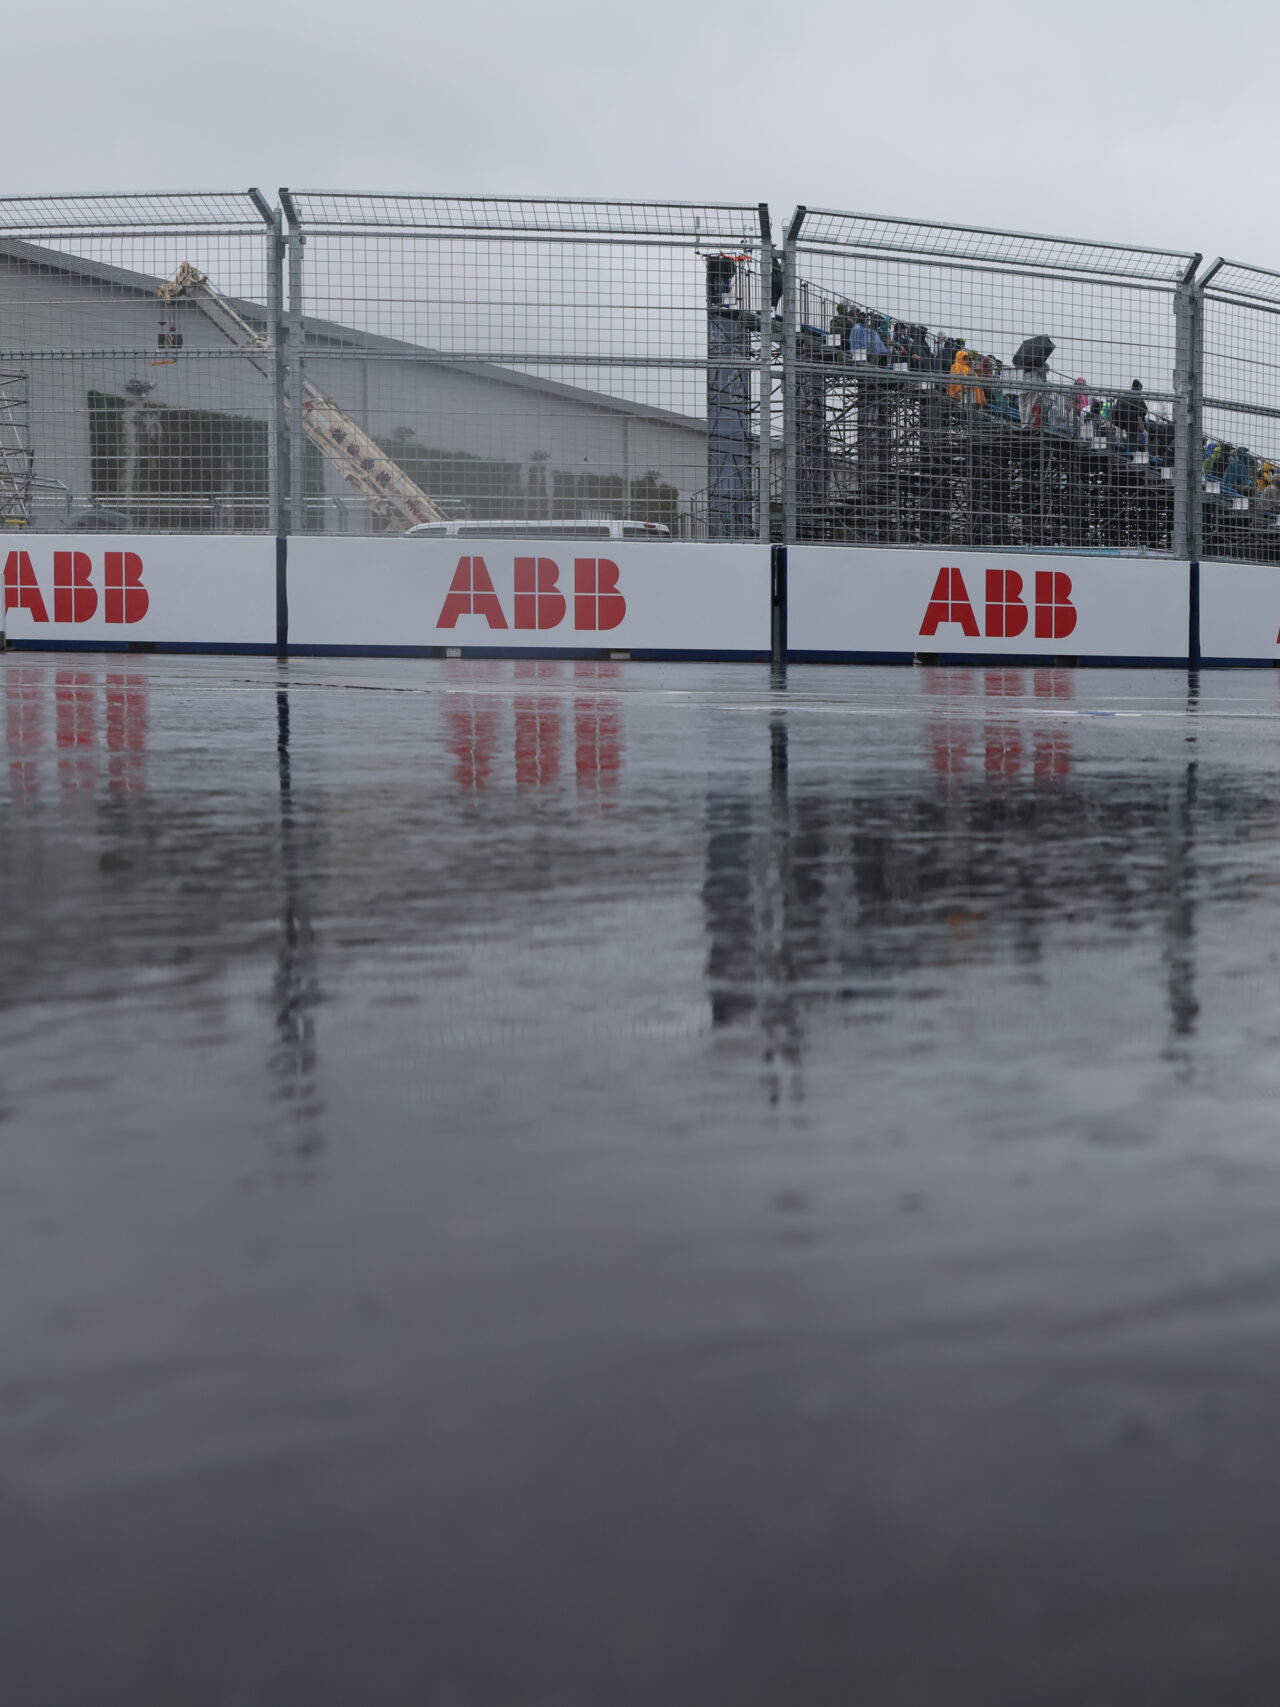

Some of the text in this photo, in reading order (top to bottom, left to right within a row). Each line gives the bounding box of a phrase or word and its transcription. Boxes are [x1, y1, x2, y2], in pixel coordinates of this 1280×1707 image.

[4, 551, 149, 624] ABB
[436, 556, 627, 631] ABB
[919, 567, 1077, 639] ABB
